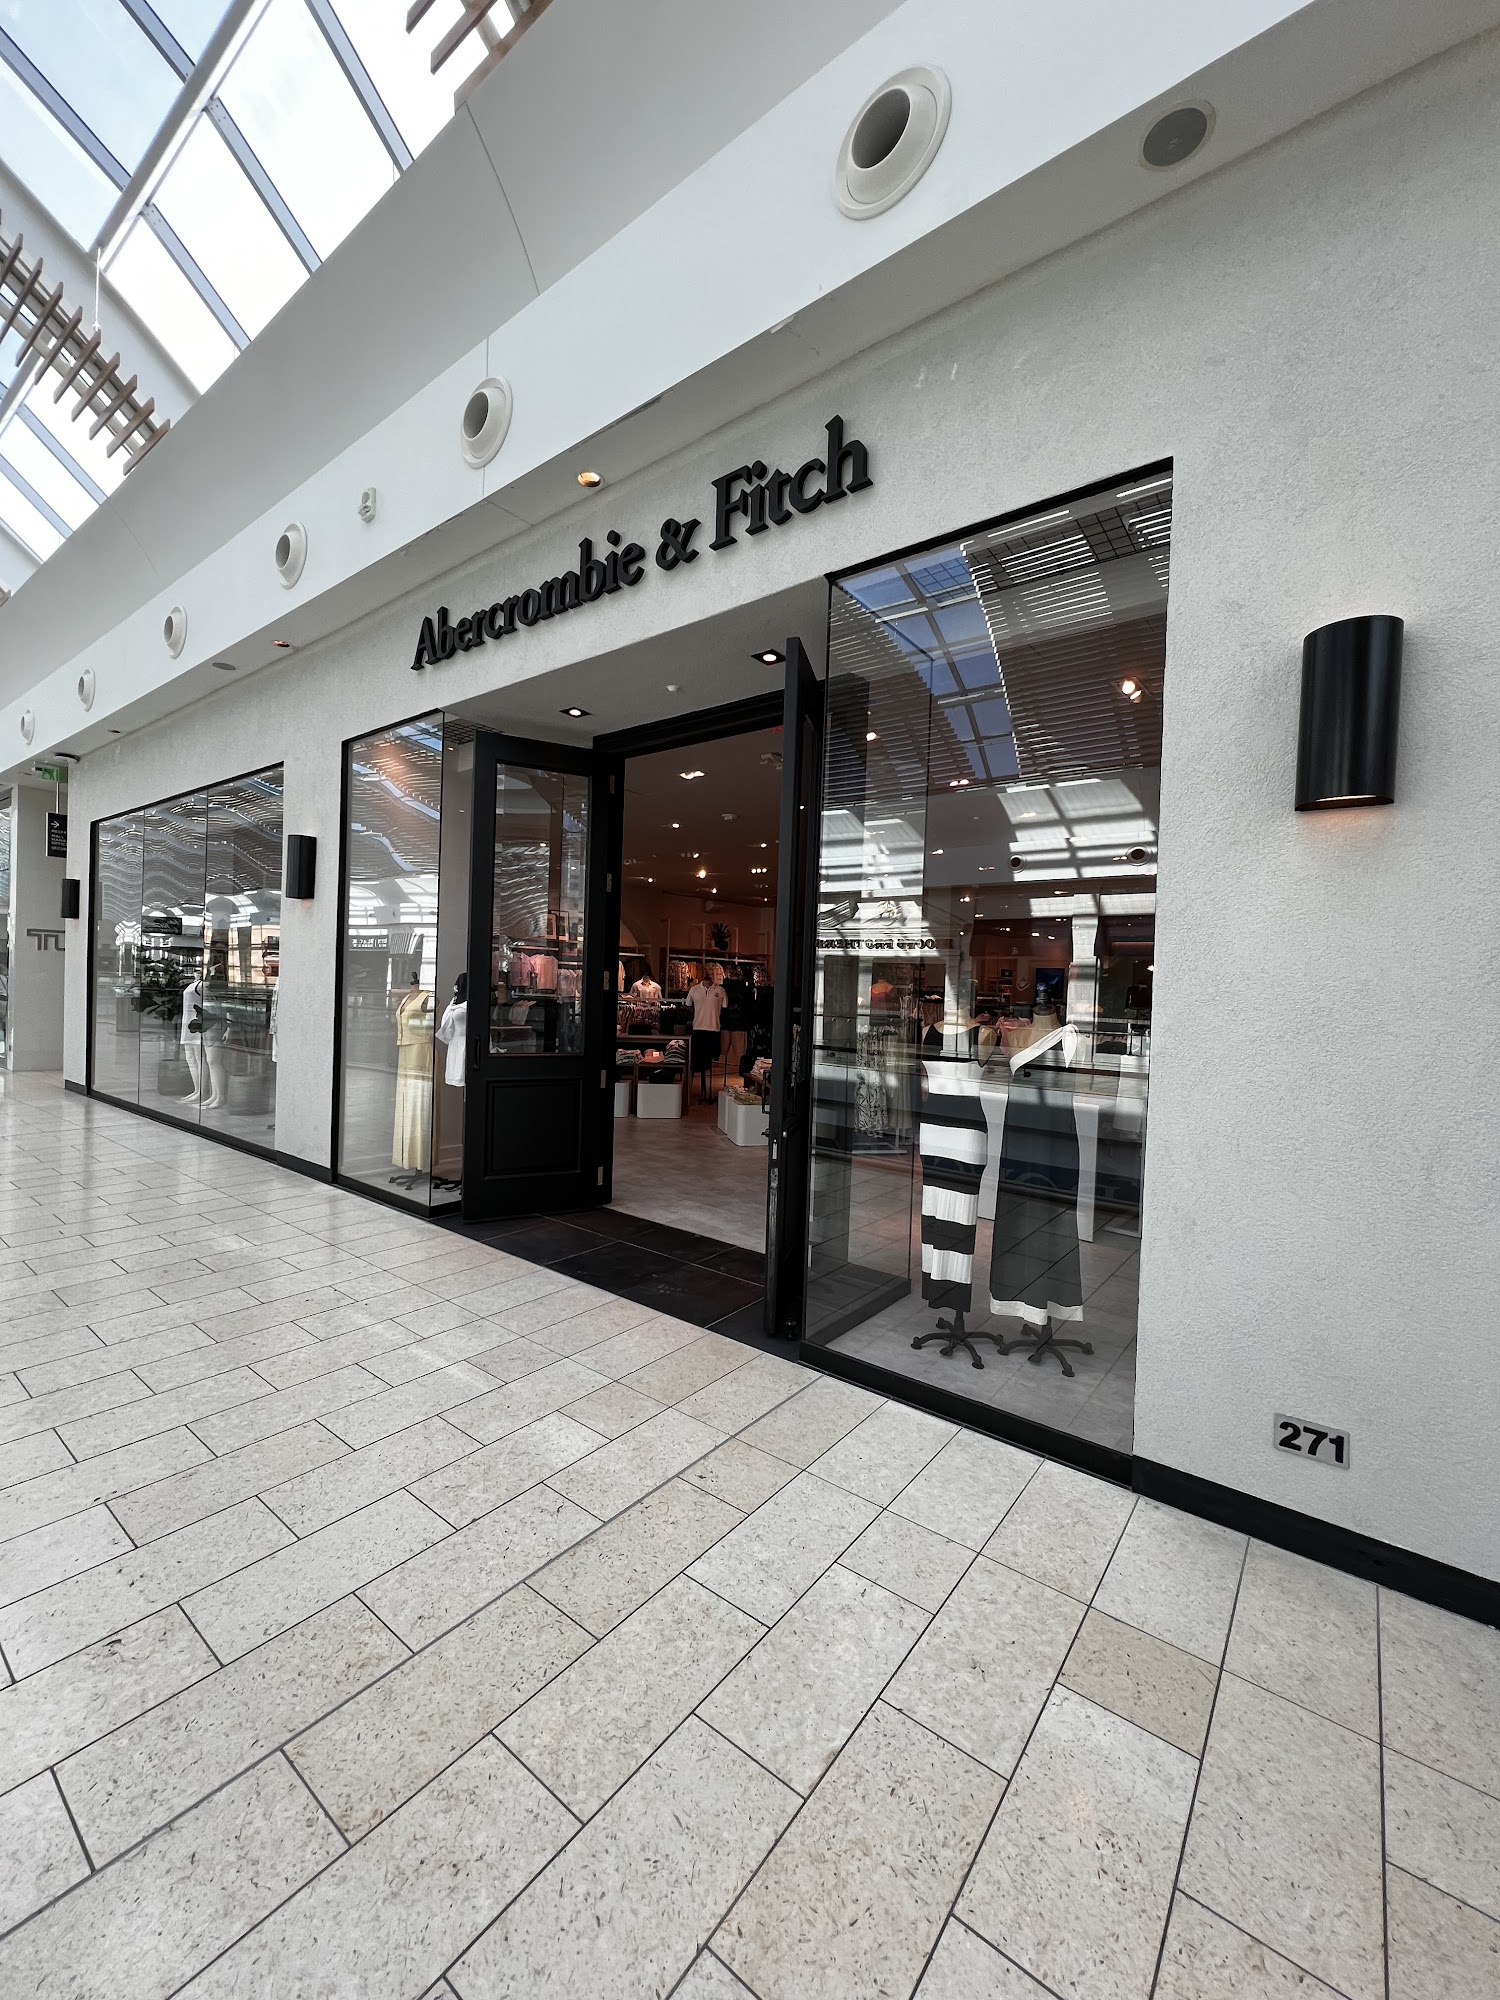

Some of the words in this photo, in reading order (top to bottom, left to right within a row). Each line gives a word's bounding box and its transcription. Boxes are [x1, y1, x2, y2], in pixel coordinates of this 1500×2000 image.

[411, 530, 645, 670] Abercrombie
[656, 518, 701, 571] &
[709, 414, 874, 550] Fitch
[1279, 1421, 1345, 1464] 271
